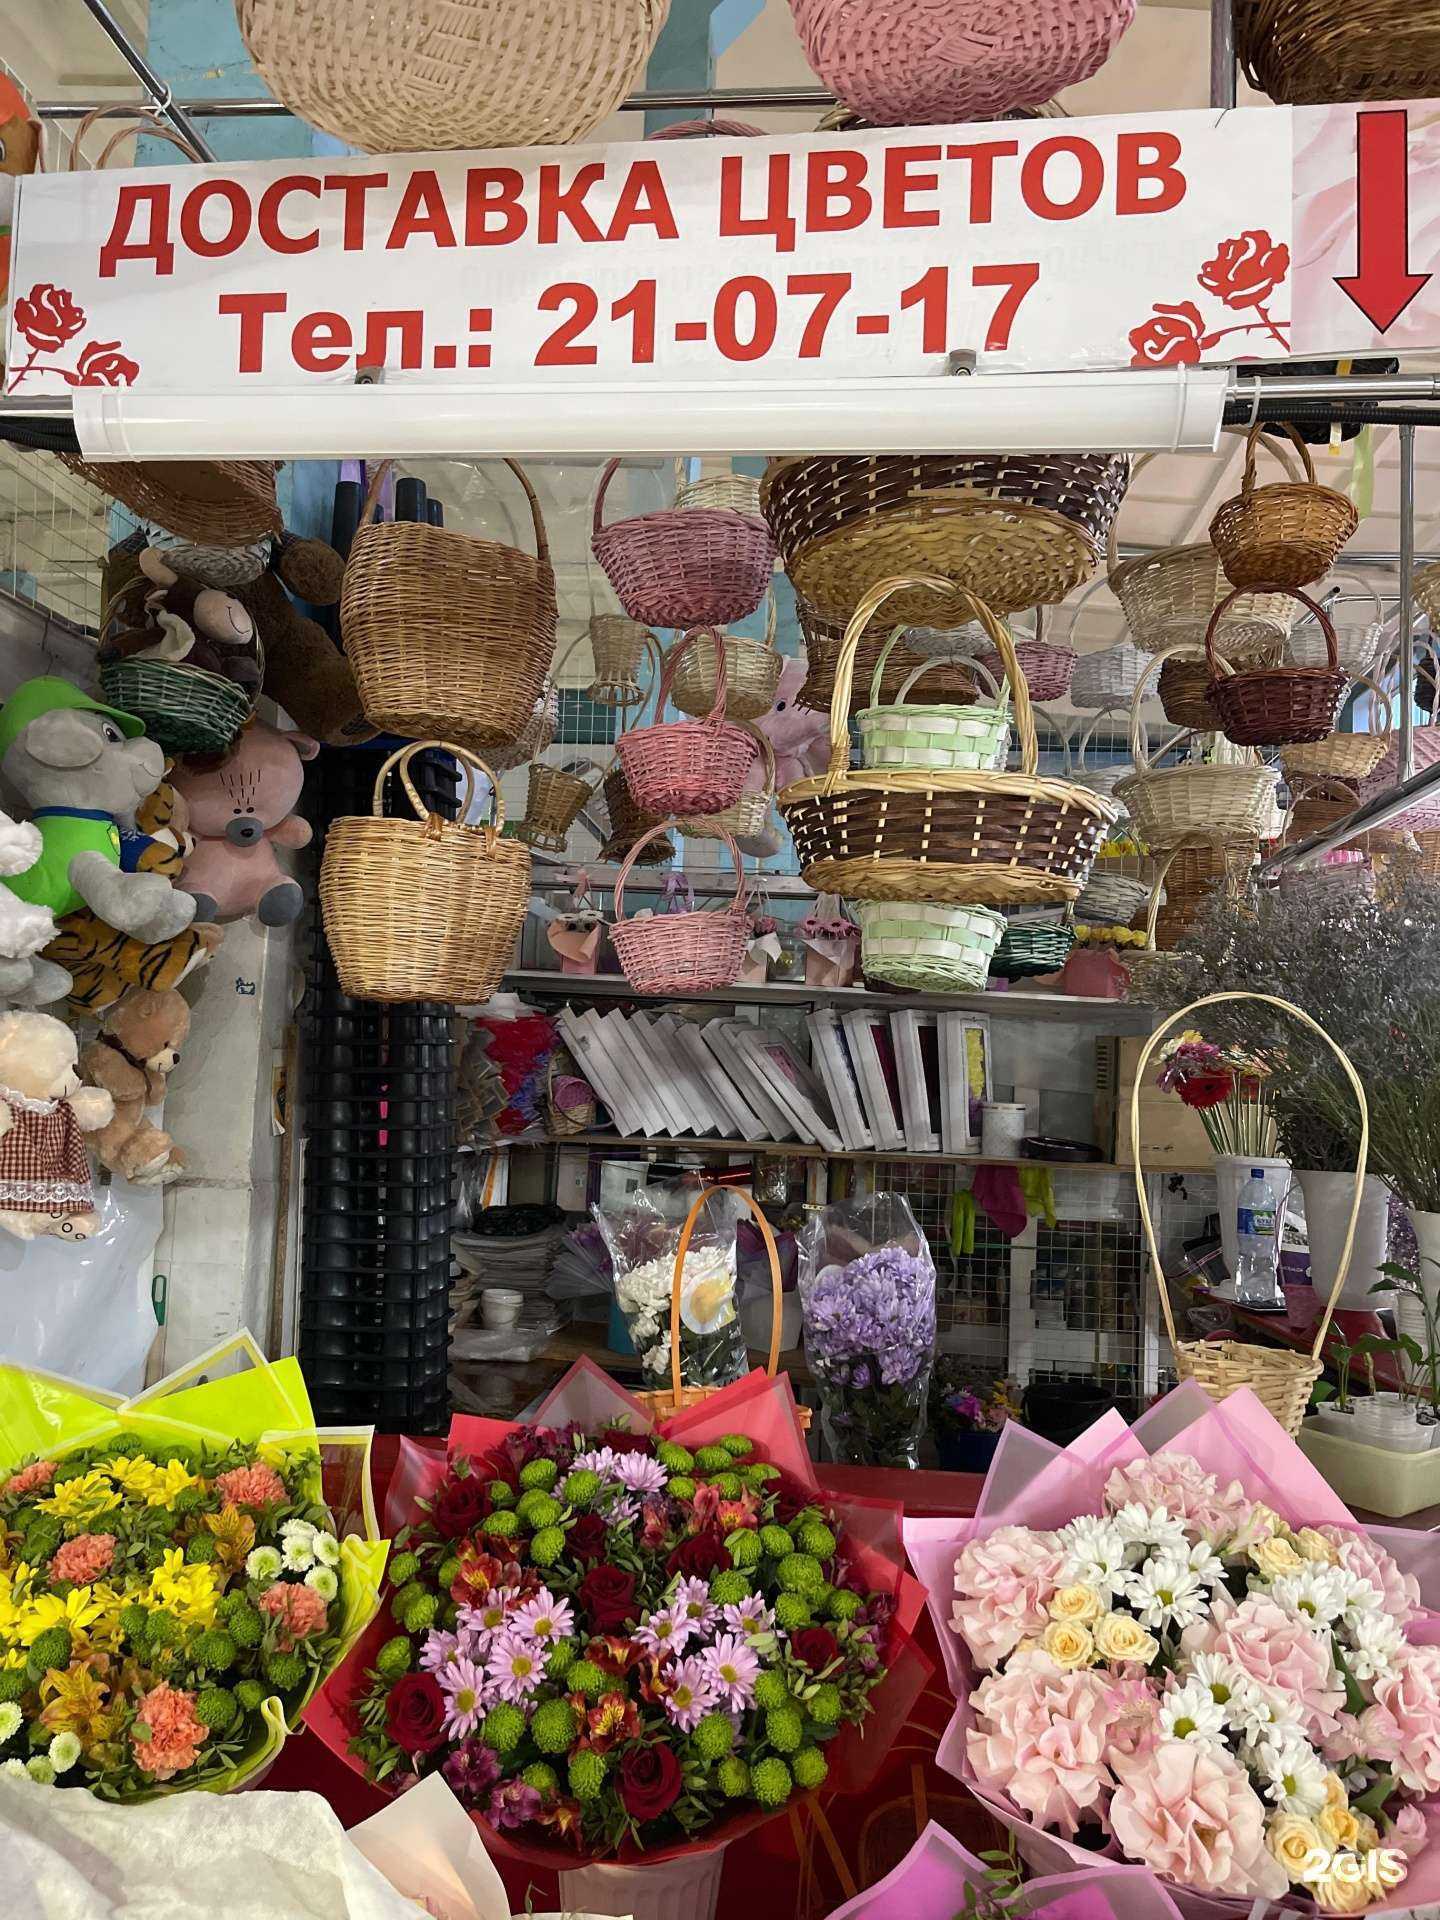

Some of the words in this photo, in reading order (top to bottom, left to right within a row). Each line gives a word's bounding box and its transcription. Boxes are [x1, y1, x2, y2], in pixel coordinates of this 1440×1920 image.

[99, 161, 680, 278] ДОСТАВКА
[719, 131, 1187, 253] ЦВЕТОВ
[218, 291, 493, 373] Тел.:
[534, 262, 1040, 367] 21-07-17
